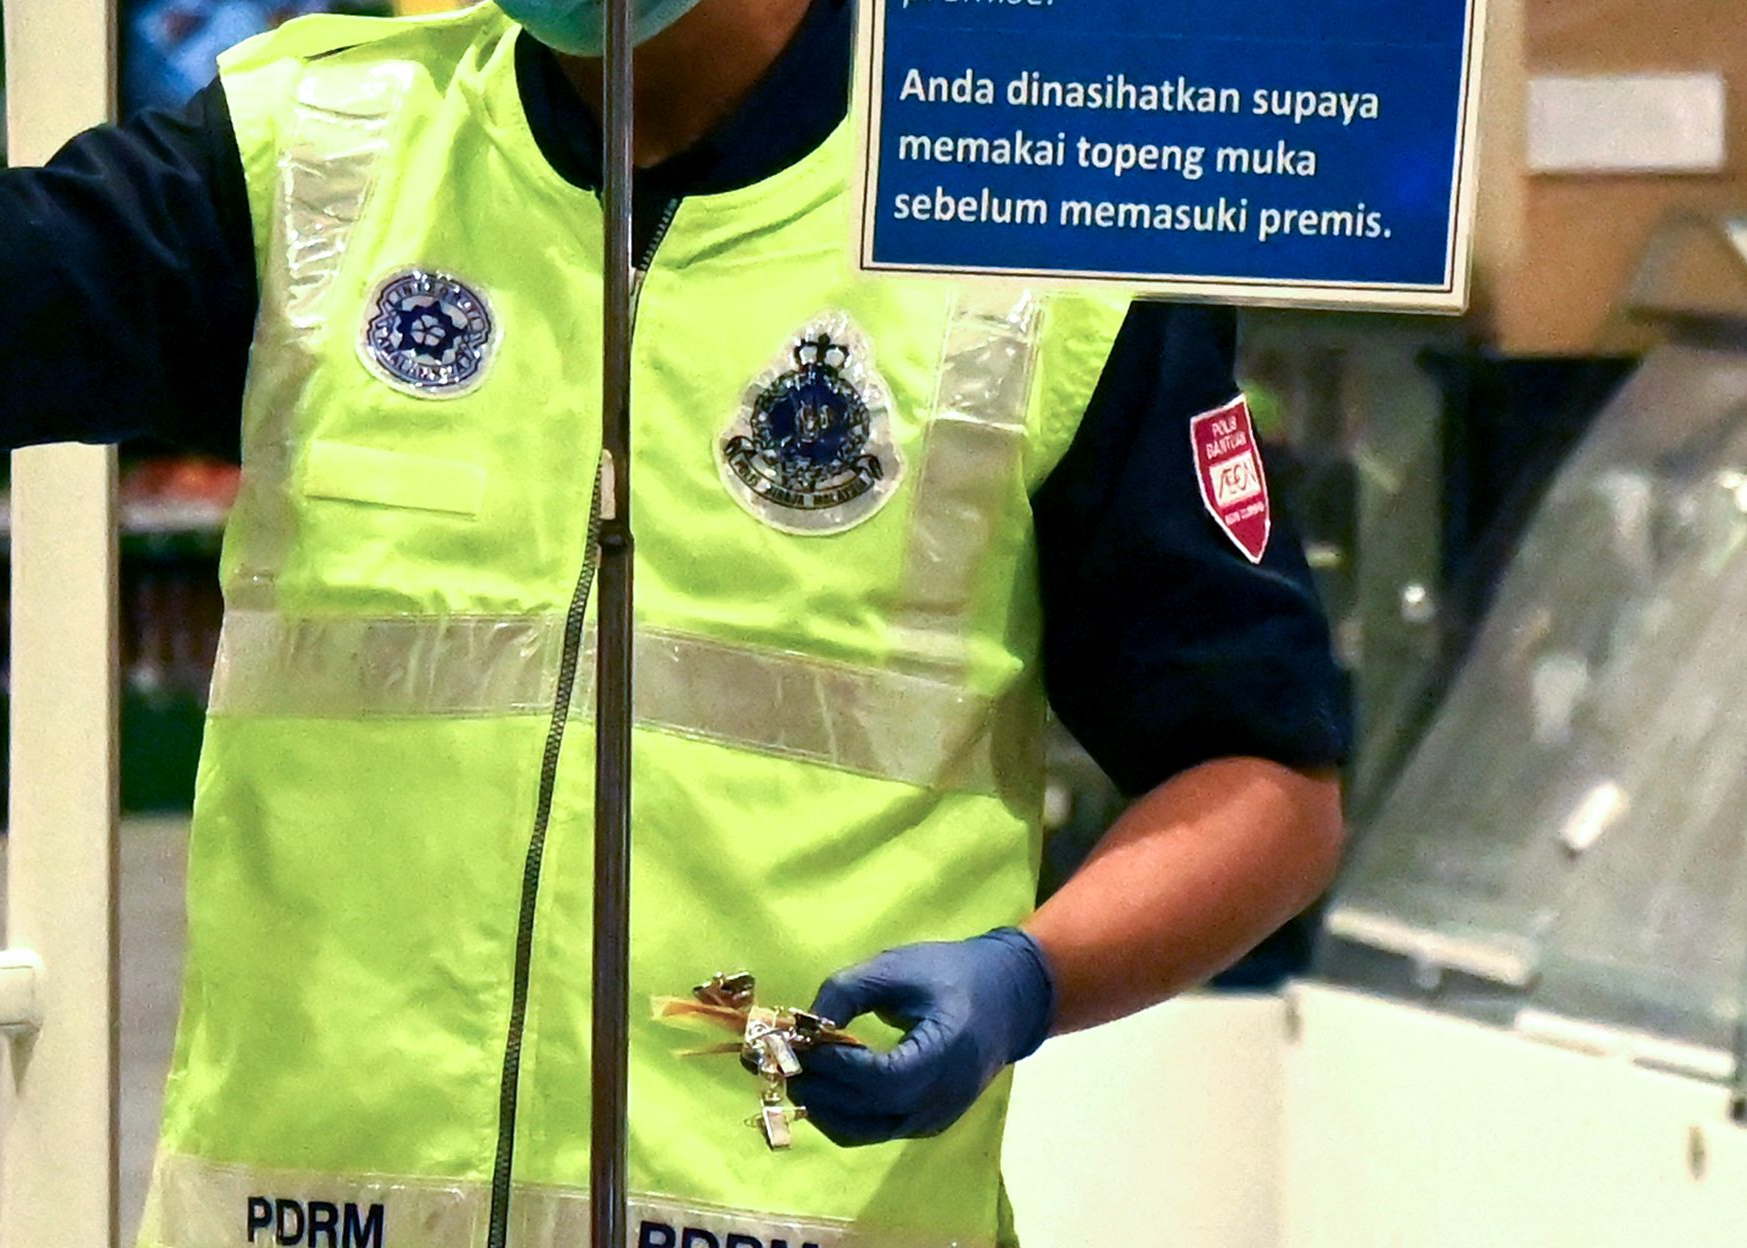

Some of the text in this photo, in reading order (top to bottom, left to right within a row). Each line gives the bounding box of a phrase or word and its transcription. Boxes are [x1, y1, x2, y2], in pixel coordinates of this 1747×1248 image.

[900, 68, 1379, 126] Anda dinasihatkan supaya
[898, 129, 1316, 181] memakai topeng muka
[893, 185, 1391, 242] sebelum memasuki premis.
[247, 1196, 384, 1248] PDRM
